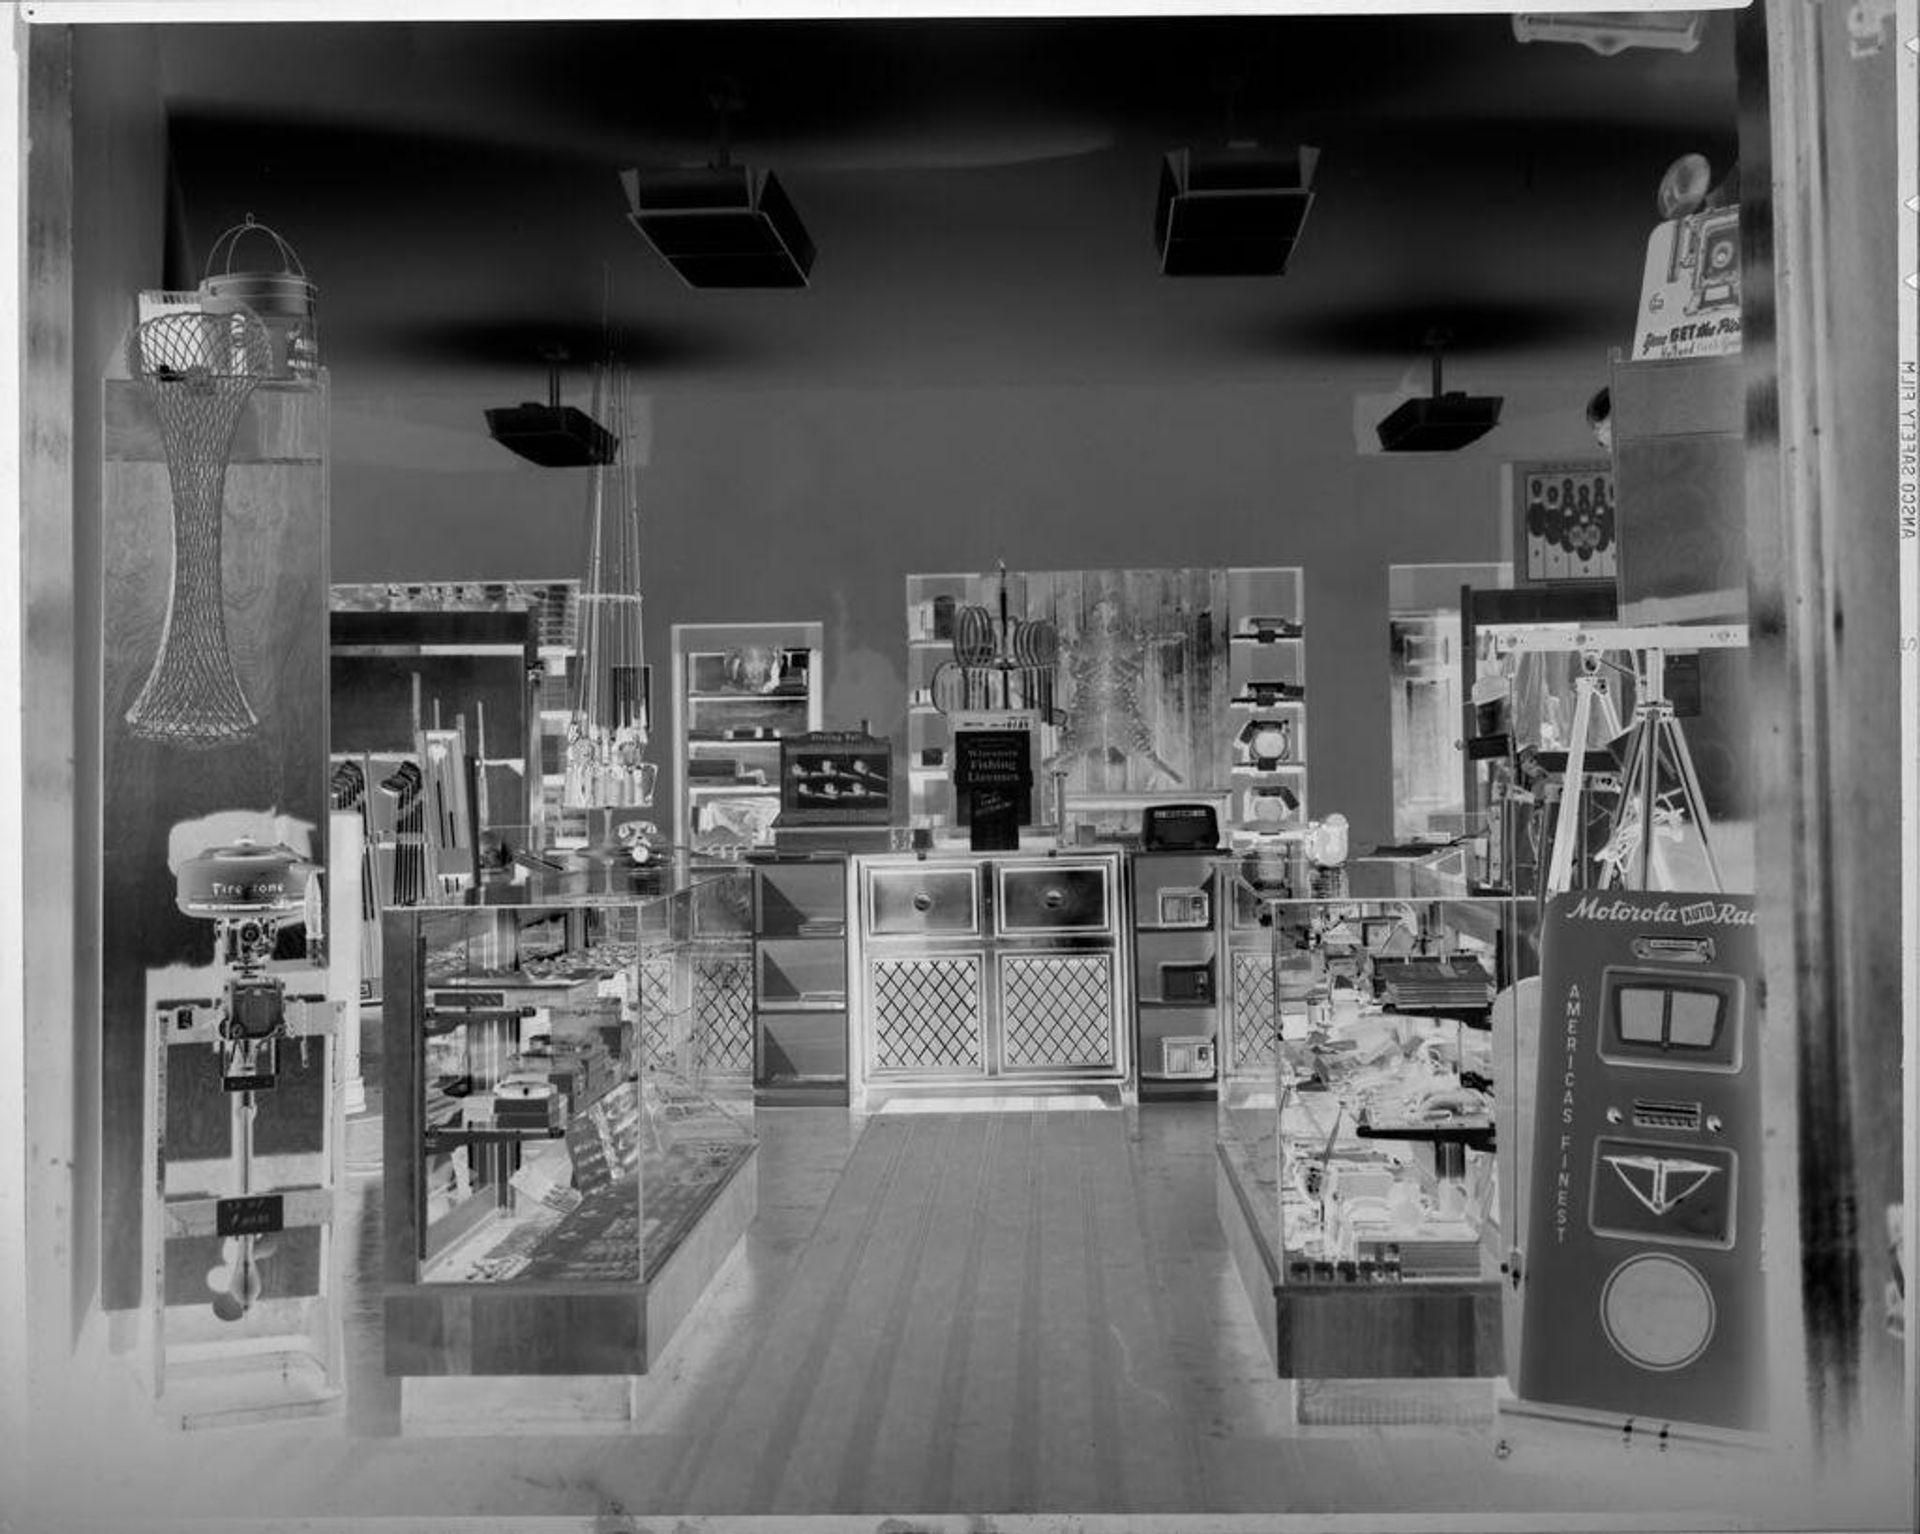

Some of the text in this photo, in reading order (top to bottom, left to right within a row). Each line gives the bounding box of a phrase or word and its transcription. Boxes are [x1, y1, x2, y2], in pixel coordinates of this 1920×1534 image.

[1671, 323, 1698, 343] GET
[1566, 896, 1678, 923] Motorola
[1681, 902, 1716, 925] AUTO
[1562, 983, 1580, 1124] AMERICAS
[1557, 1135, 1572, 1243] FINEST
